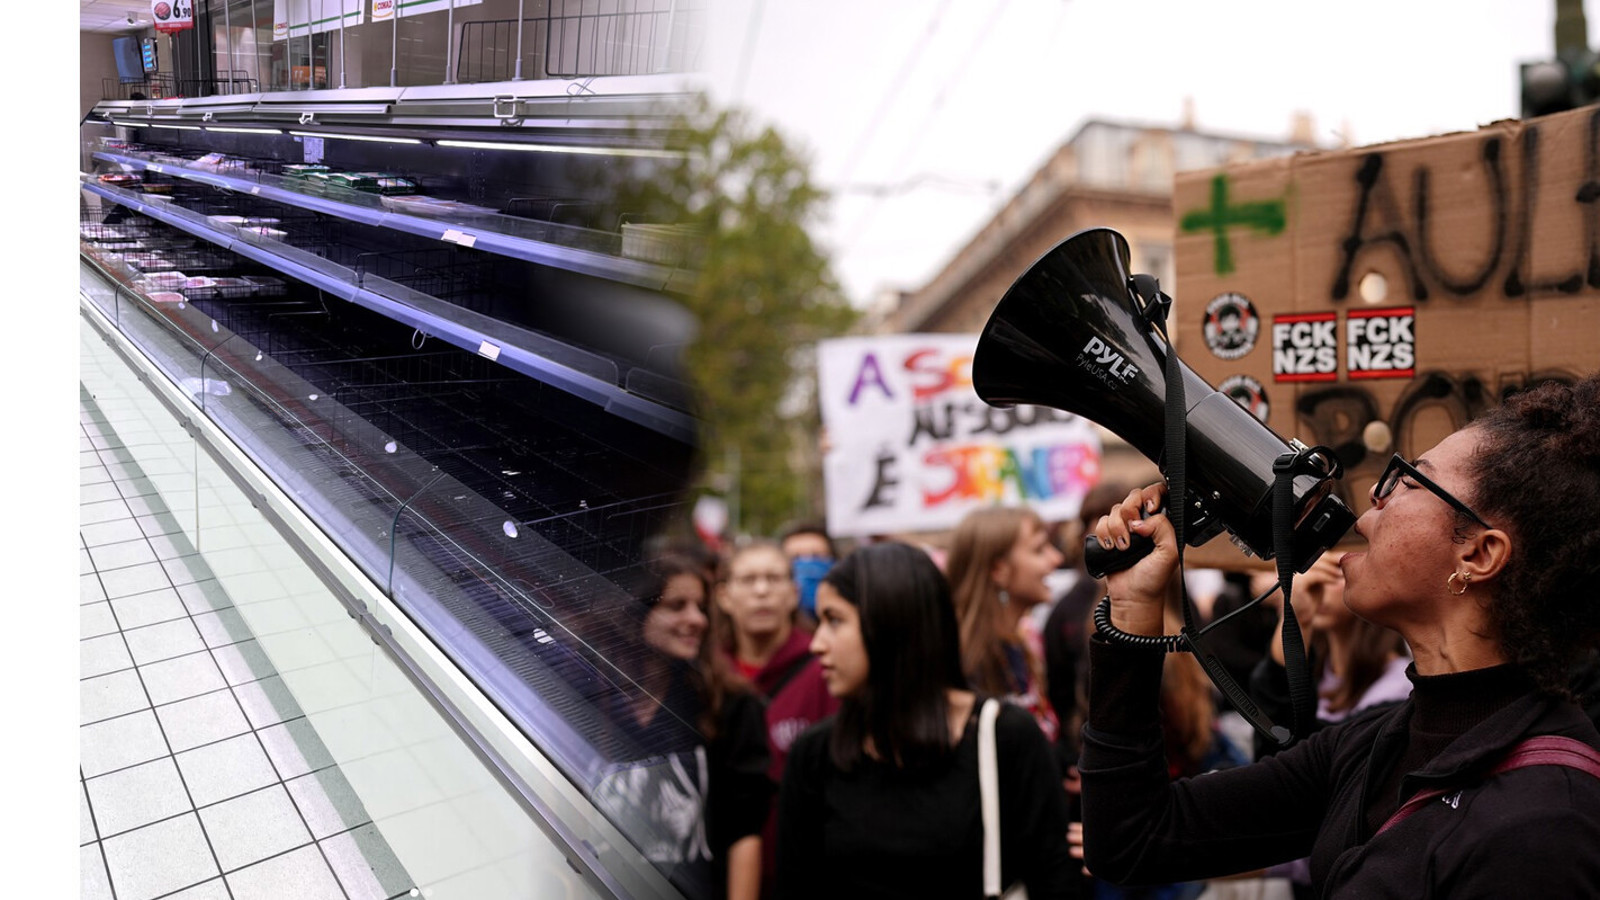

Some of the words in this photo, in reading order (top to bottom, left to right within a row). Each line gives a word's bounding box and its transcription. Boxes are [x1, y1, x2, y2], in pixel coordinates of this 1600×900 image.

[1273, 320, 1337, 349] FCK
[1344, 315, 1414, 344] FCK
[1082, 335, 1139, 385] PYLE
[1273, 346, 1337, 375] NZS
[1346, 342, 1414, 371] NZS
[848, 352, 895, 404] A
